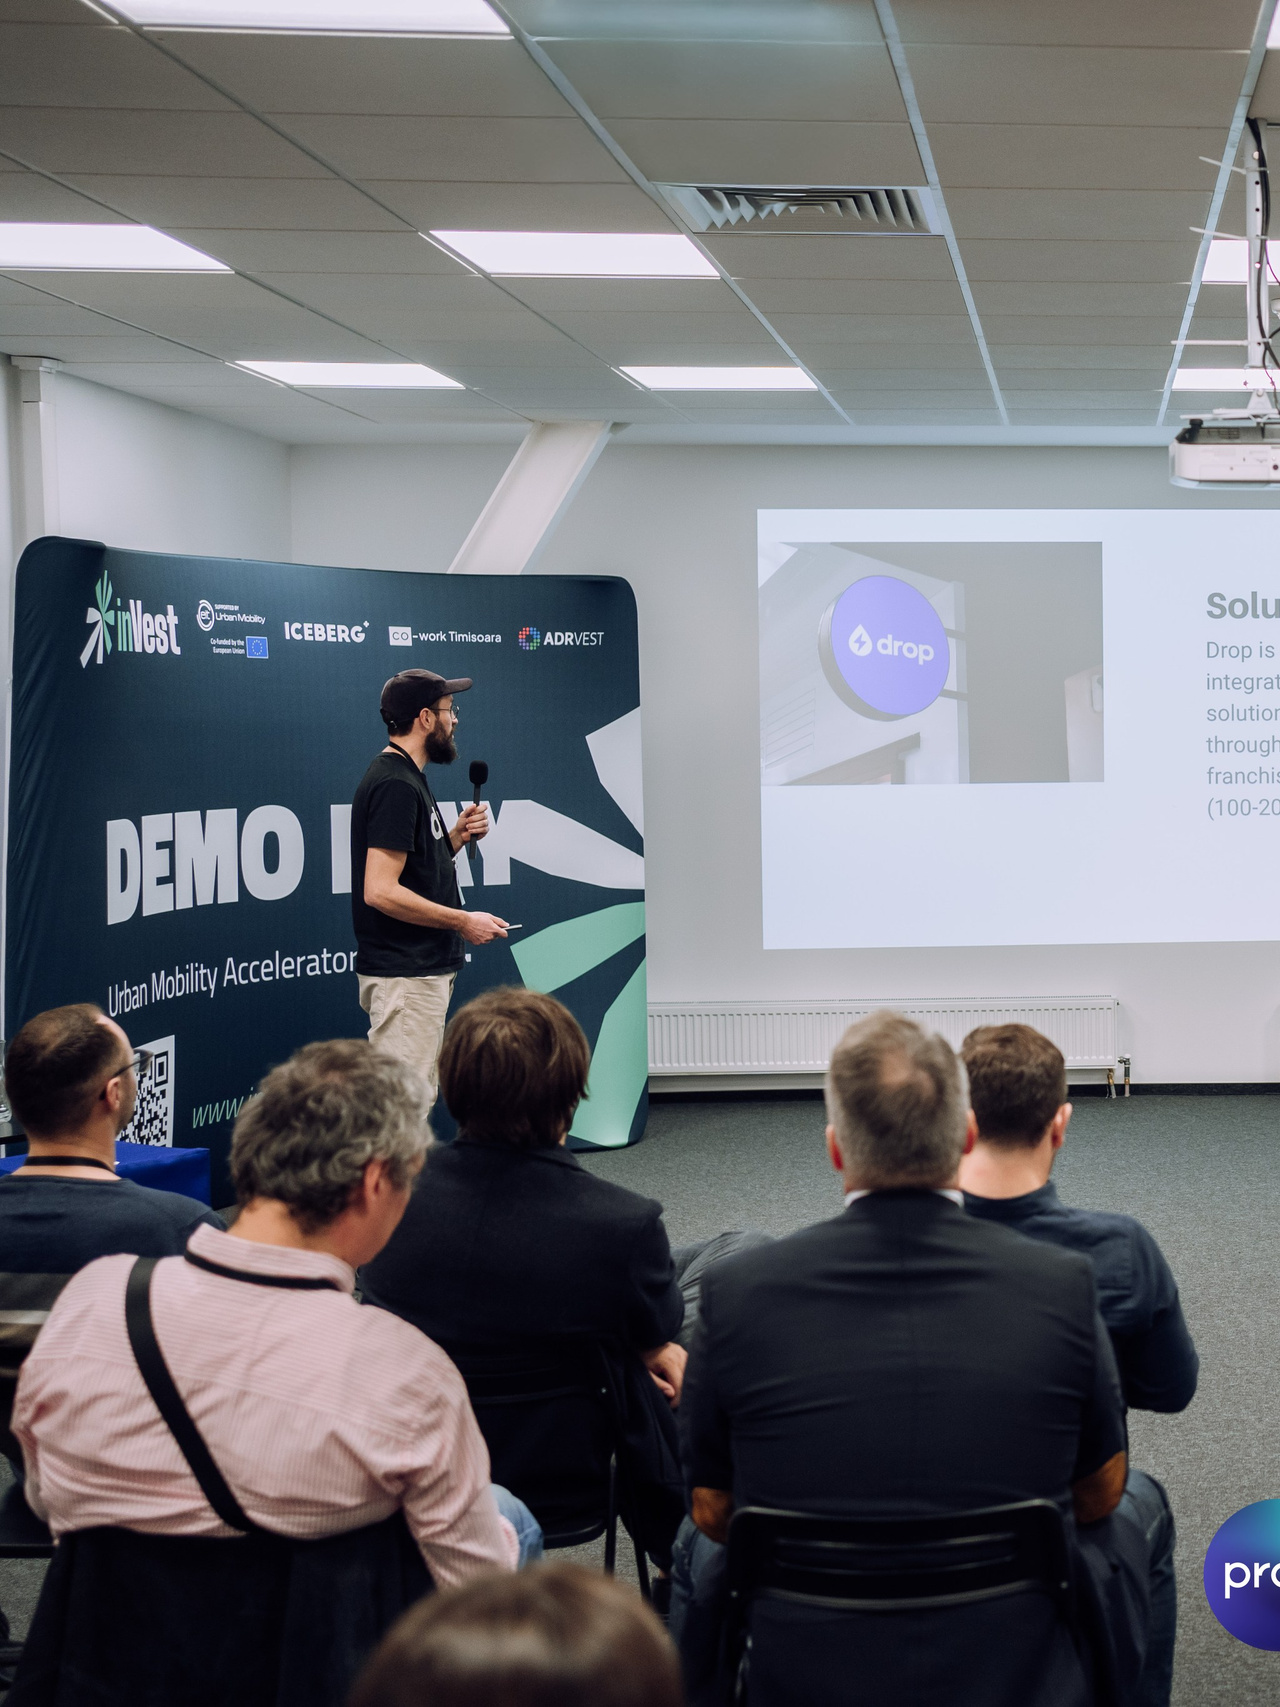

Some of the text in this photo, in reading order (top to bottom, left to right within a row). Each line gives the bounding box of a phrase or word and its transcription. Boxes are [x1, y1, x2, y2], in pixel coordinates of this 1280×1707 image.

[216, 612, 266, 624] Urban Mobility
[448, 630, 502, 644] Timisoara
[544, 631, 604, 646] ADRVEST
[213, 646, 232, 654] European
[876, 634, 934, 666] drop
[1206, 641, 1252, 663] Drop
[1258, 641, 1276, 659] is
[107, 805, 304, 926] DEMO
[108, 948, 358, 1018] Urban Mobility Accelerator
